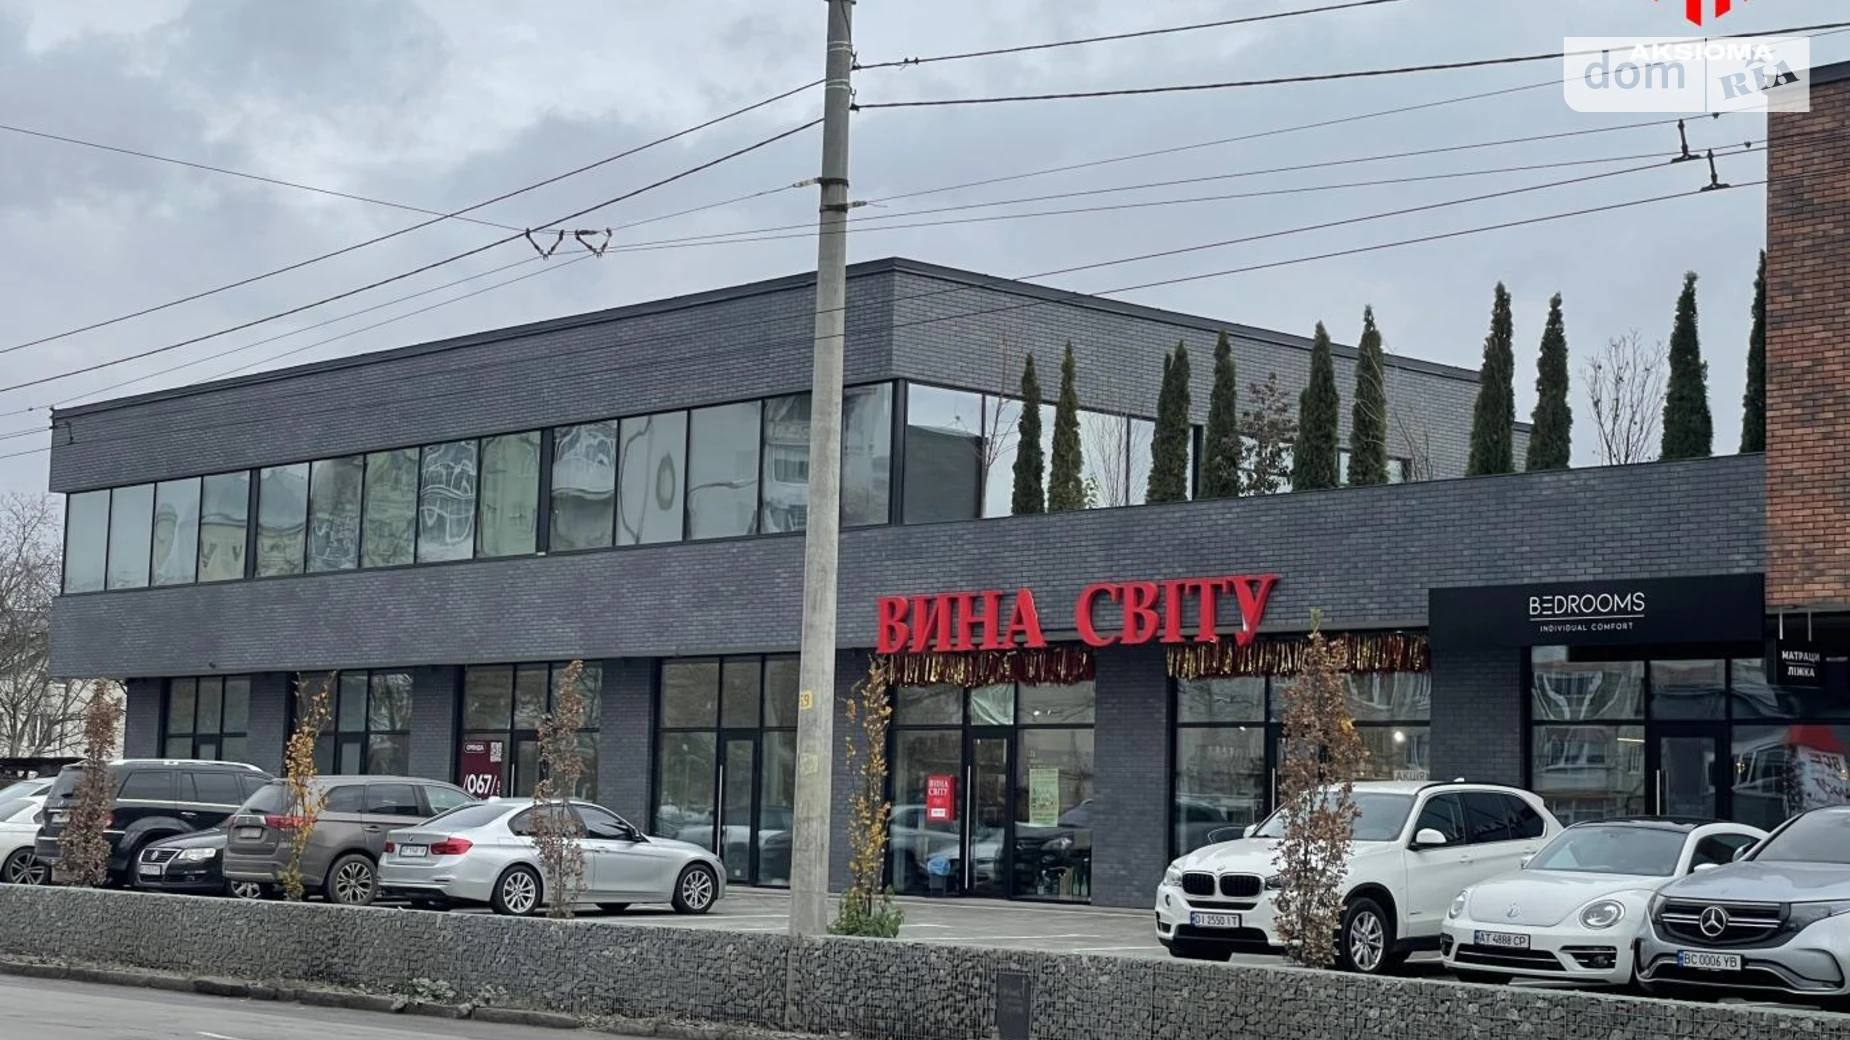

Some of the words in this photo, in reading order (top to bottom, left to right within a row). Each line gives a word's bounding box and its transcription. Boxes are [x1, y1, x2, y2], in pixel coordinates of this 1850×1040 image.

[1529, 592, 1645, 615] BEDROOMS
[876, 588, 1047, 654] ВИНА
[1075, 573, 1281, 647] СВІТУ
[1540, 624, 1588, 632] INDIVIDUAL
[1591, 622, 1633, 631] COMFORT
[1781, 651, 1820, 663] МАТРАЦИ
[1787, 666, 1815, 677] ЛІЖКА
[1195, 914, 1204, 924] DI
[1480, 932, 1491, 942] AT
[1513, 936, 1526, 946] CP
[1684, 953, 1697, 965] BC
[1699, 954, 1721, 967] 0006
